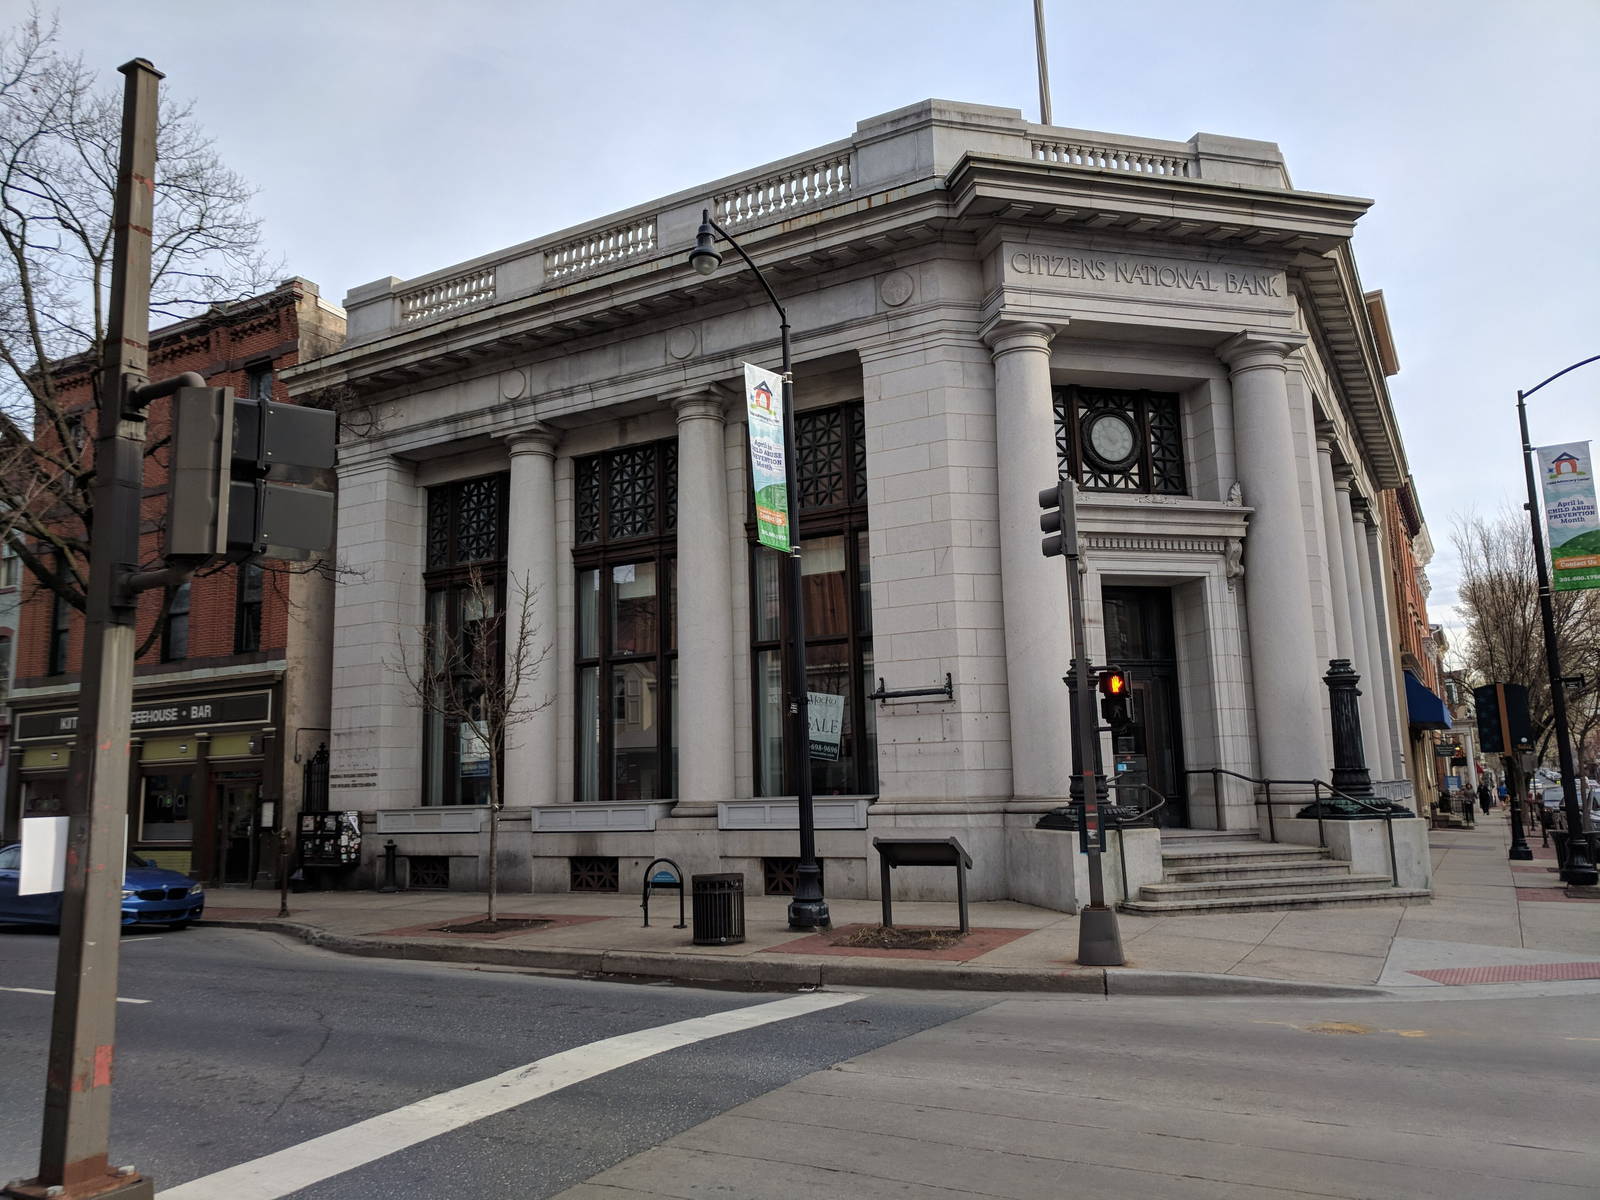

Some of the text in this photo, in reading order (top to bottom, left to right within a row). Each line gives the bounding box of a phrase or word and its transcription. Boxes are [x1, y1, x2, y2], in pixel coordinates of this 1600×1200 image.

[1010, 253, 1282, 298] CITIZENS NATIONAL BANK
[1549, 510, 1595, 520] PREVENTION
[1560, 516, 1585, 524] Month
[132, 708, 178, 724] FEEHOUSE
[191, 705, 212, 719] BAR
